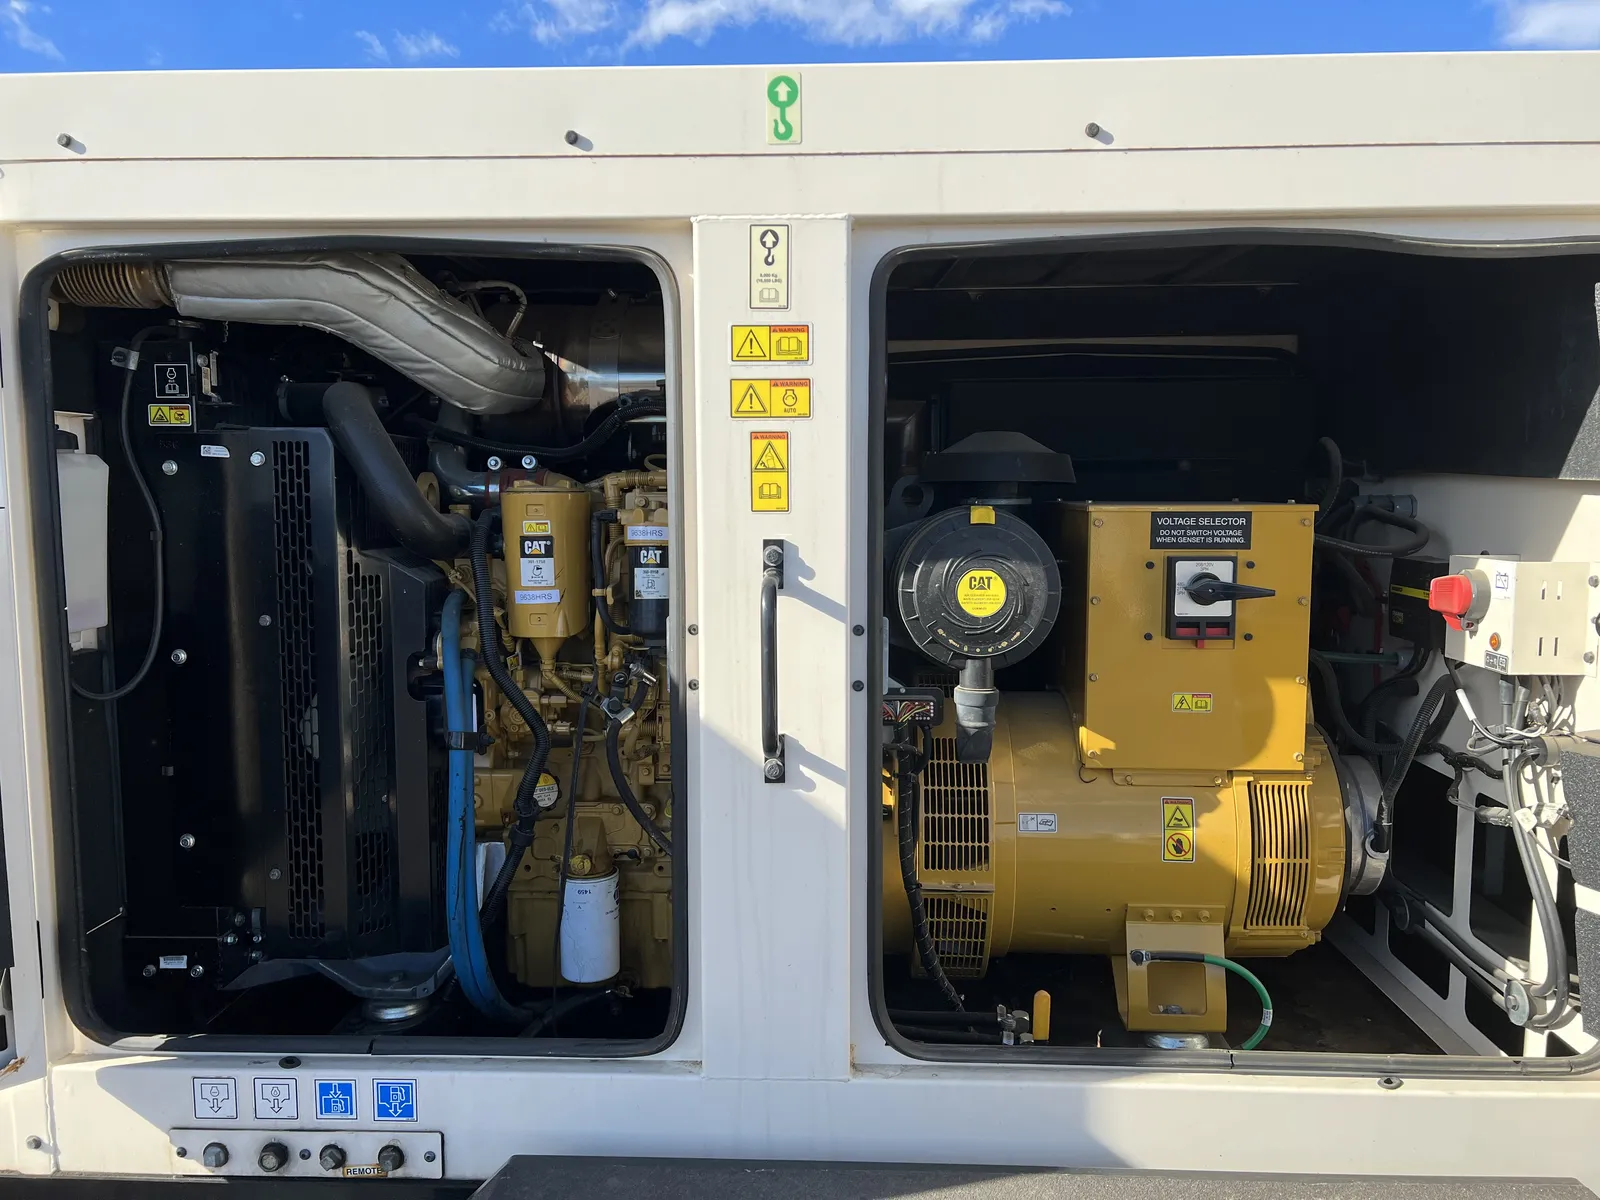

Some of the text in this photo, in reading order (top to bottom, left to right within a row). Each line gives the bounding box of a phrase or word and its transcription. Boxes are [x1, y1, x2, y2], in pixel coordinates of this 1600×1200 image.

[1157, 517, 1246, 526] VOLTAGE SELECTOR
[630, 529, 663, 537] 9638HRS
[524, 540, 545, 555] CAT
[640, 549, 662, 564] CAT
[969, 576, 993, 590] CAT
[519, 592, 553, 600] 9638HRS
[346, 1167, 382, 1175] REMOTE
